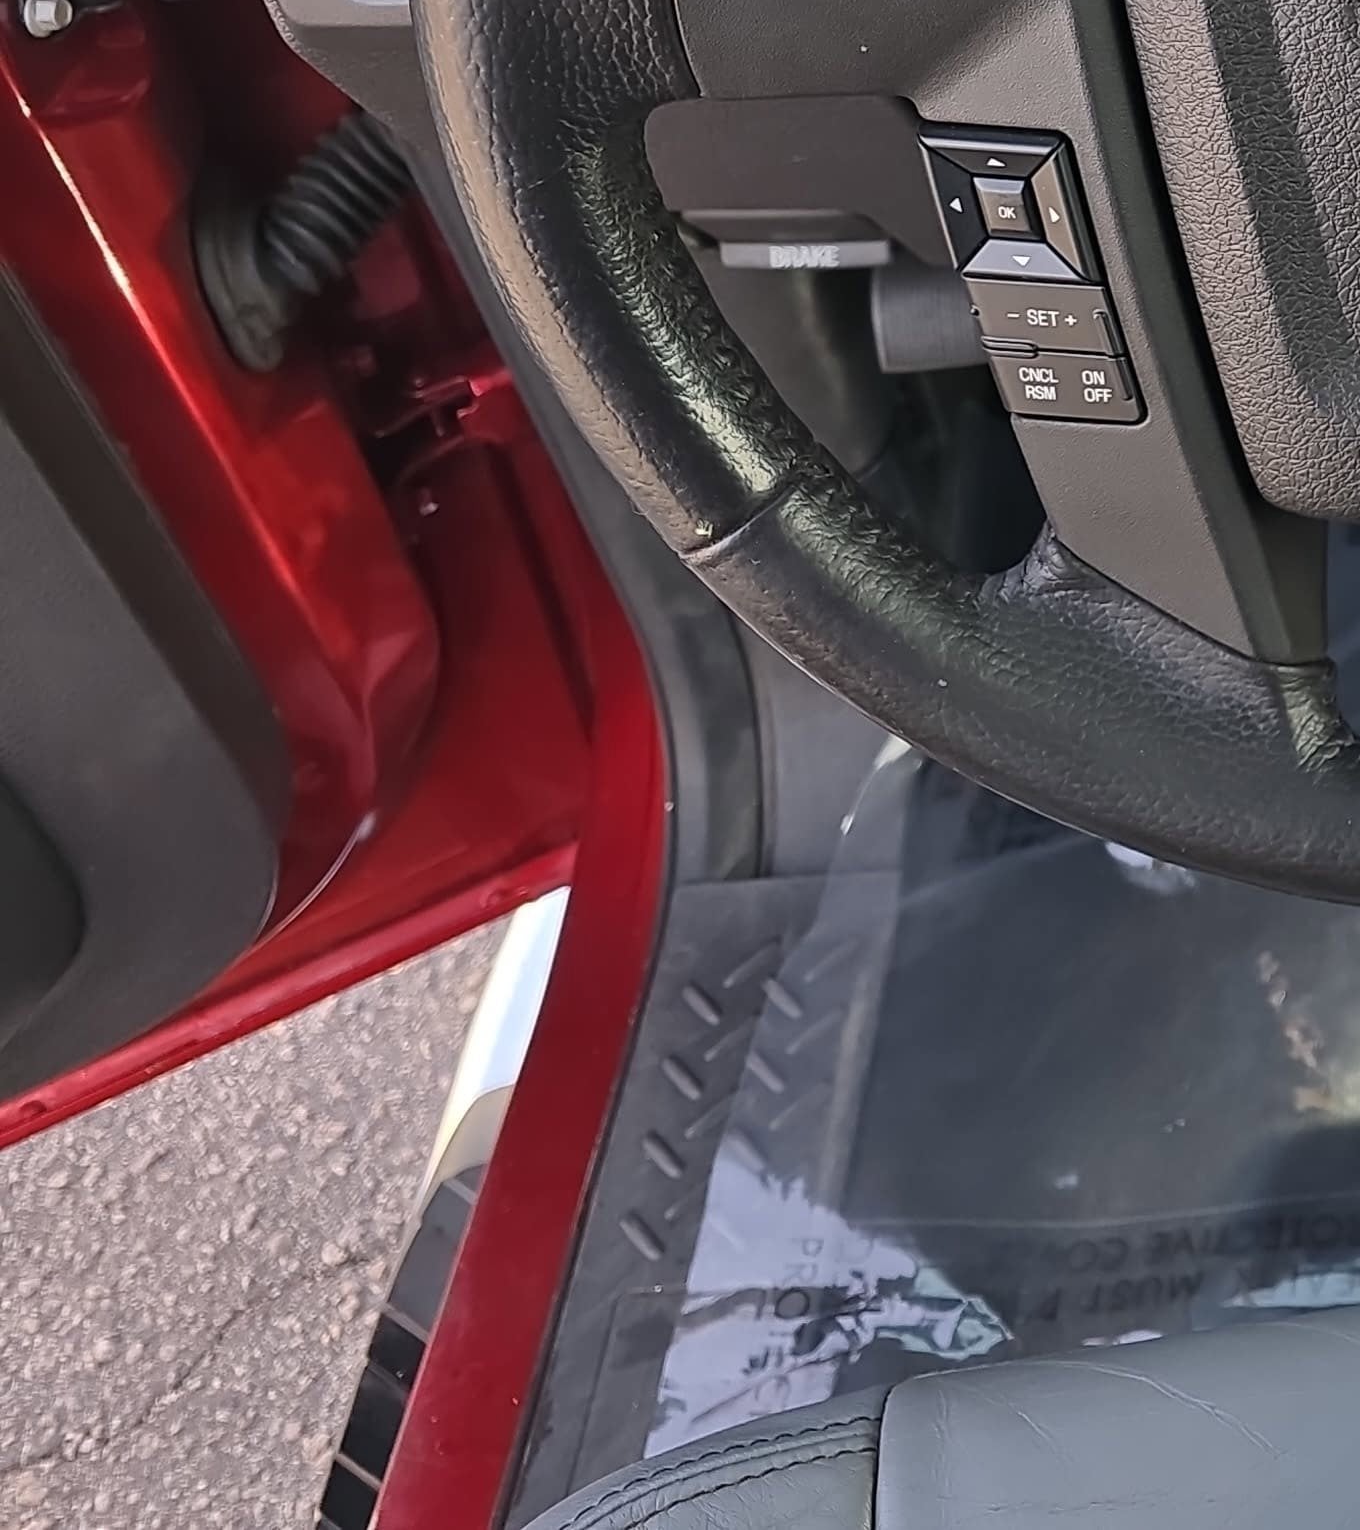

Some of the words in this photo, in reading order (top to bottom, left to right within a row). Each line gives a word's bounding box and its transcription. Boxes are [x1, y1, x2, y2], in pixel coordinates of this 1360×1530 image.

[998, 206, 1016, 219] OK
[768, 245, 840, 268] BRAKE
[1027, 309, 1059, 326] SET
[1018, 367, 1058, 384] CNCL
[1082, 371, 1105, 385] ON
[1025, 385, 1056, 401] RSM
[1084, 387, 1112, 403] OFF
